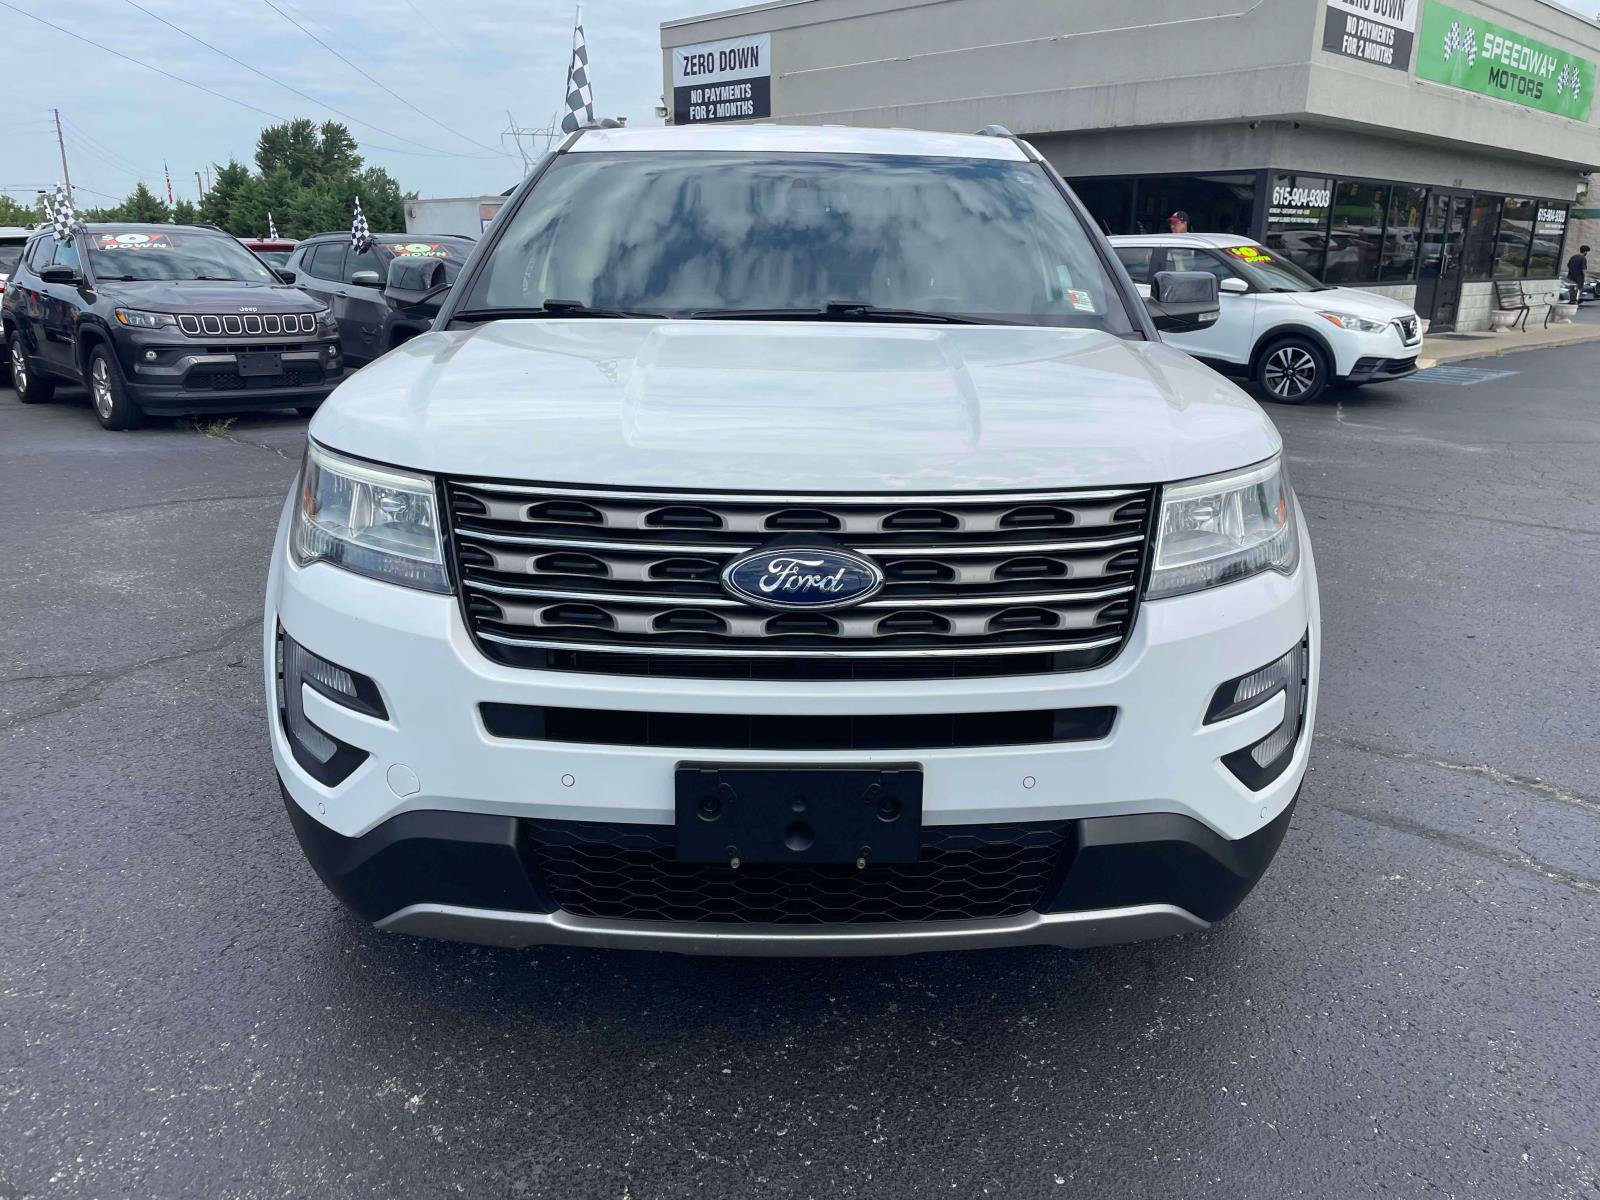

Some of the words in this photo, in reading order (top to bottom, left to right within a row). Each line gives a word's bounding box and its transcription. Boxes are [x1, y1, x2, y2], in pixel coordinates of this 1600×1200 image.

[1345, 15, 1357, 34] NO
[1357, 19, 1395, 45] PAYMENTS
[683, 52, 714, 76] ZERO
[719, 45, 759, 72] DOWN
[1342, 34, 1358, 55] FOR
[1357, 40, 1364, 57] 2
[1364, 41, 1394, 65] MONTHS
[1481, 32, 1557, 79] SPEEDWAY
[690, 89, 702, 104] NO
[704, 83, 752, 102] PAYMENTS
[1488, 66, 1544, 100] MOTORS
[690, 105, 707, 120] FOR
[708, 104, 714, 119] 2
[716, 100, 754, 118] MONTHS
[1273, 186, 1330, 208] 615-904-9303
[758, 557, 846, 593] Ford
